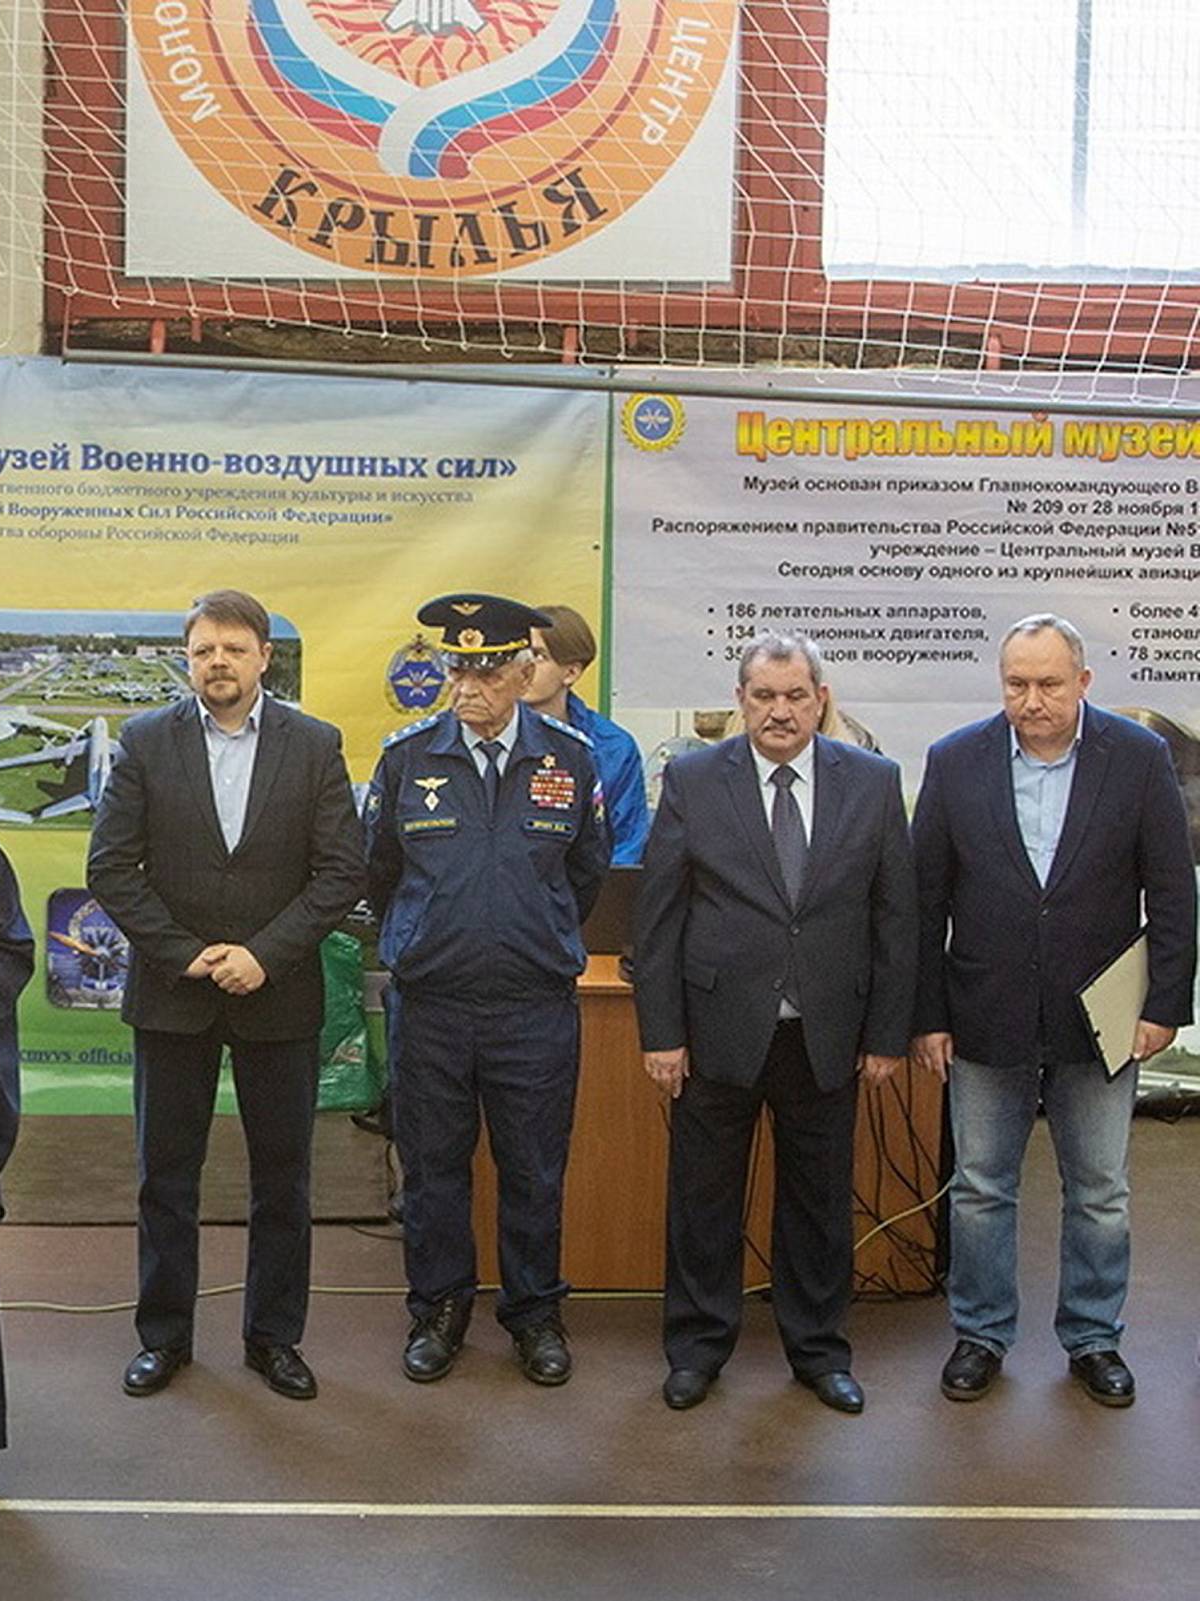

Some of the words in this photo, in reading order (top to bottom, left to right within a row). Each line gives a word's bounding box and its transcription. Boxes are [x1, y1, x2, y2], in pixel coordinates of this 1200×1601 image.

[642, 16, 710, 145] ЦЕНТР
[253, 163, 608, 269] КРЫЛЬЯ
[736, 409, 1054, 462] Центральный
[1062, 416, 1200, 463] музей
[81, 444, 428, 483] Военно-воздушных
[436, 455, 518, 480] сил»
[77, 482, 181, 499] бюджетного
[184, 486, 288, 501] учреждения
[291, 488, 374, 504] культуры
[377, 490, 387, 501] и
[392, 490, 474, 506] искусства
[744, 475, 799, 494] Музей
[805, 478, 881, 492] основан
[887, 479, 973, 496] приказом
[979, 477, 1181, 497] Главнокомандующего
[8, 503, 134, 521] Вооруженных
[138, 504, 171, 518] Сил
[176, 505, 277, 521] Российской
[282, 508, 393, 525] Федерации»
[1006, 500, 1028, 514] №
[1033, 500, 1064, 515] 209
[1068, 503, 1088, 515] от
[1092, 500, 1113, 515] 28
[1118, 500, 1184, 518] ноября
[28, 524, 102, 542] обороны
[106, 526, 202, 541] Российской
[206, 527, 299, 545] Федерации
[652, 517, 798, 537] Распоряжением
[803, 522, 942, 540] правительства
[947, 519, 1054, 536] Российской
[1059, 521, 1161, 541] Федерации
[869, 543, 980, 559] учреждение
[1001, 542, 1126, 560] Центральный
[1131, 544, 1185, 561] музей
[778, 561, 854, 579] Сегодня
[859, 564, 924, 582] основу
[929, 566, 993, 581] одного
[999, 566, 1018, 579] из
[1023, 564, 1134, 582] крупнейших
[726, 604, 757, 618] 186
[761, 605, 881, 619] летательных
[886, 607, 988, 621] аппаратов,
[1130, 603, 1185, 619] более
[726, 625, 756, 640] 134
[890, 628, 990, 643] двигателя,
[862, 648, 980, 664] вооружения,
[1128, 646, 1149, 661] 78
